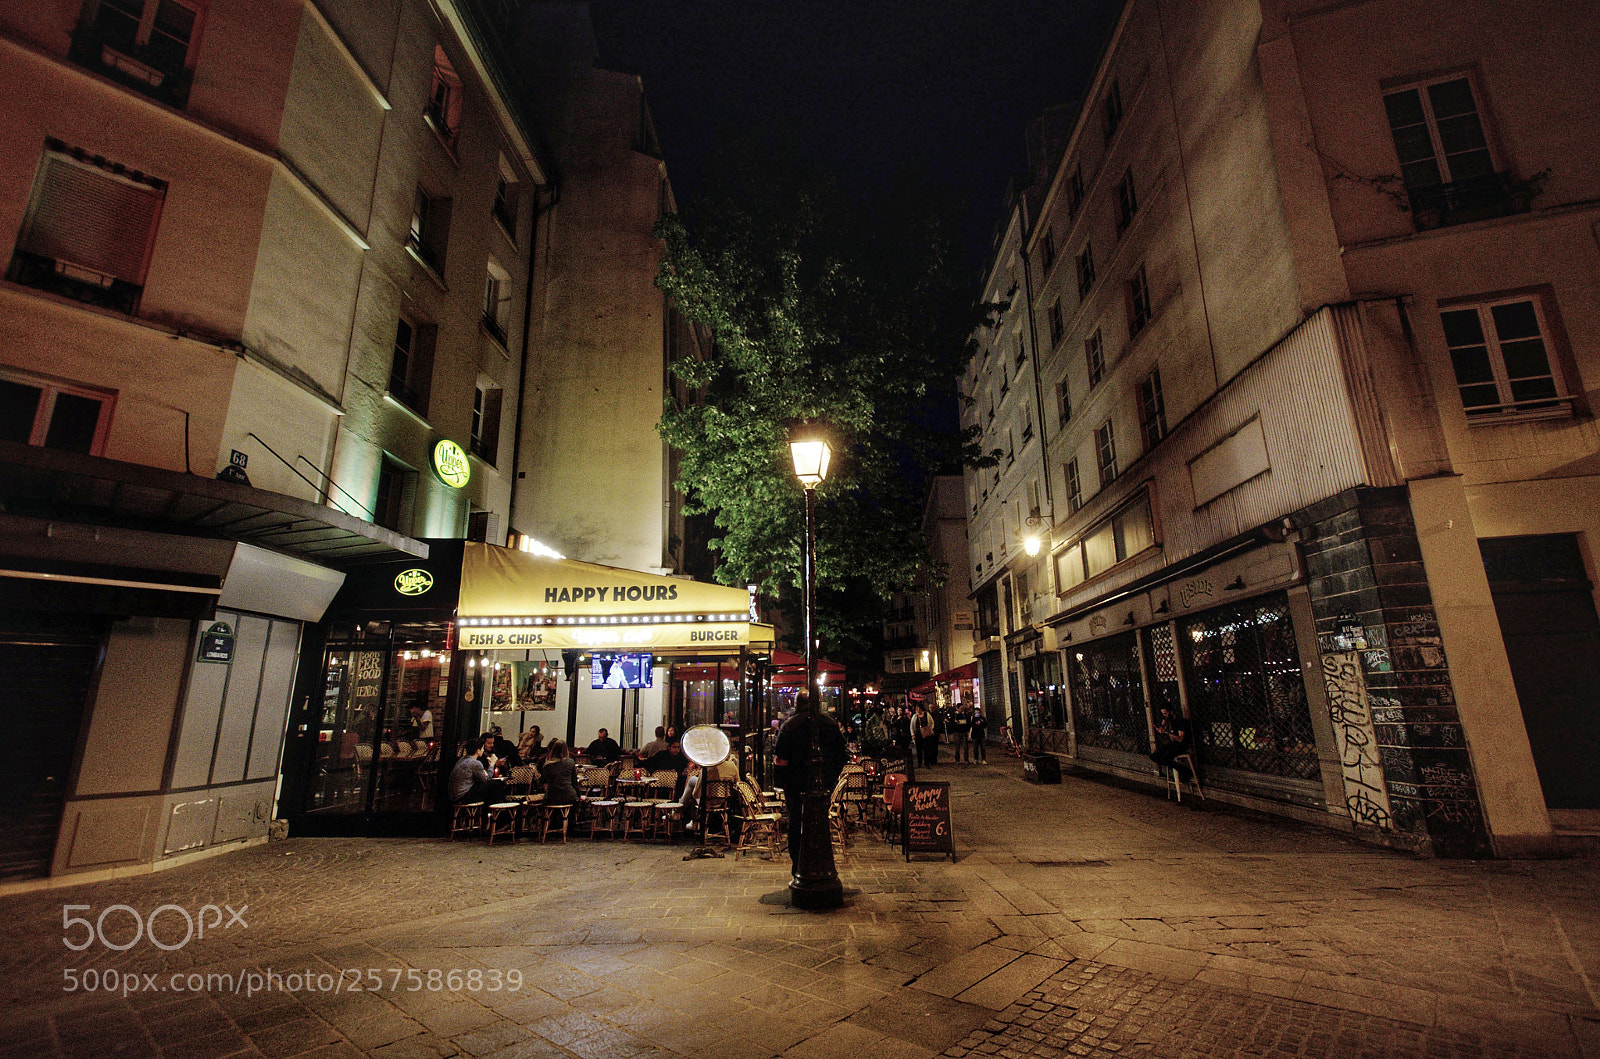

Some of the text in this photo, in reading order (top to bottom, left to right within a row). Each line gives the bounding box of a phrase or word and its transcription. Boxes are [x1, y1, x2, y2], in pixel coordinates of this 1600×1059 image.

[232, 451, 246, 467] 68
[545, 584, 678, 604] HAPPY HOURS
[469, 633, 543, 645] FISH & CHIPS
[690, 630, 738, 642] BURGER
[908, 786, 942, 802] Happy
